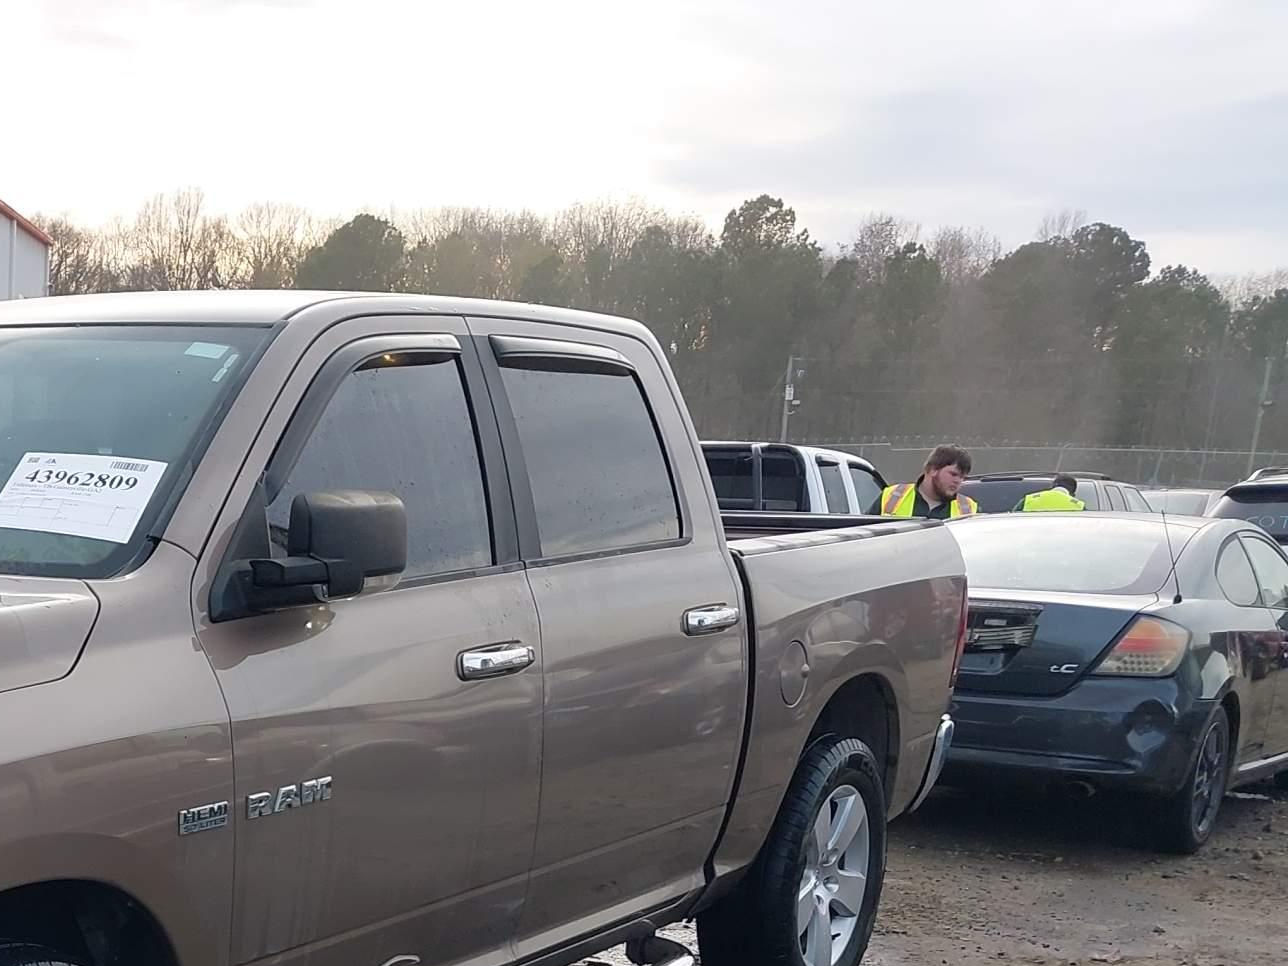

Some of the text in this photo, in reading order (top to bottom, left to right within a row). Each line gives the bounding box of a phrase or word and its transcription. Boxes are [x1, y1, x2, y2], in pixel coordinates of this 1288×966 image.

[25, 469, 139, 491] 43962809
[245, 775, 333, 820] RAM
[182, 802, 229, 826] HEMI
